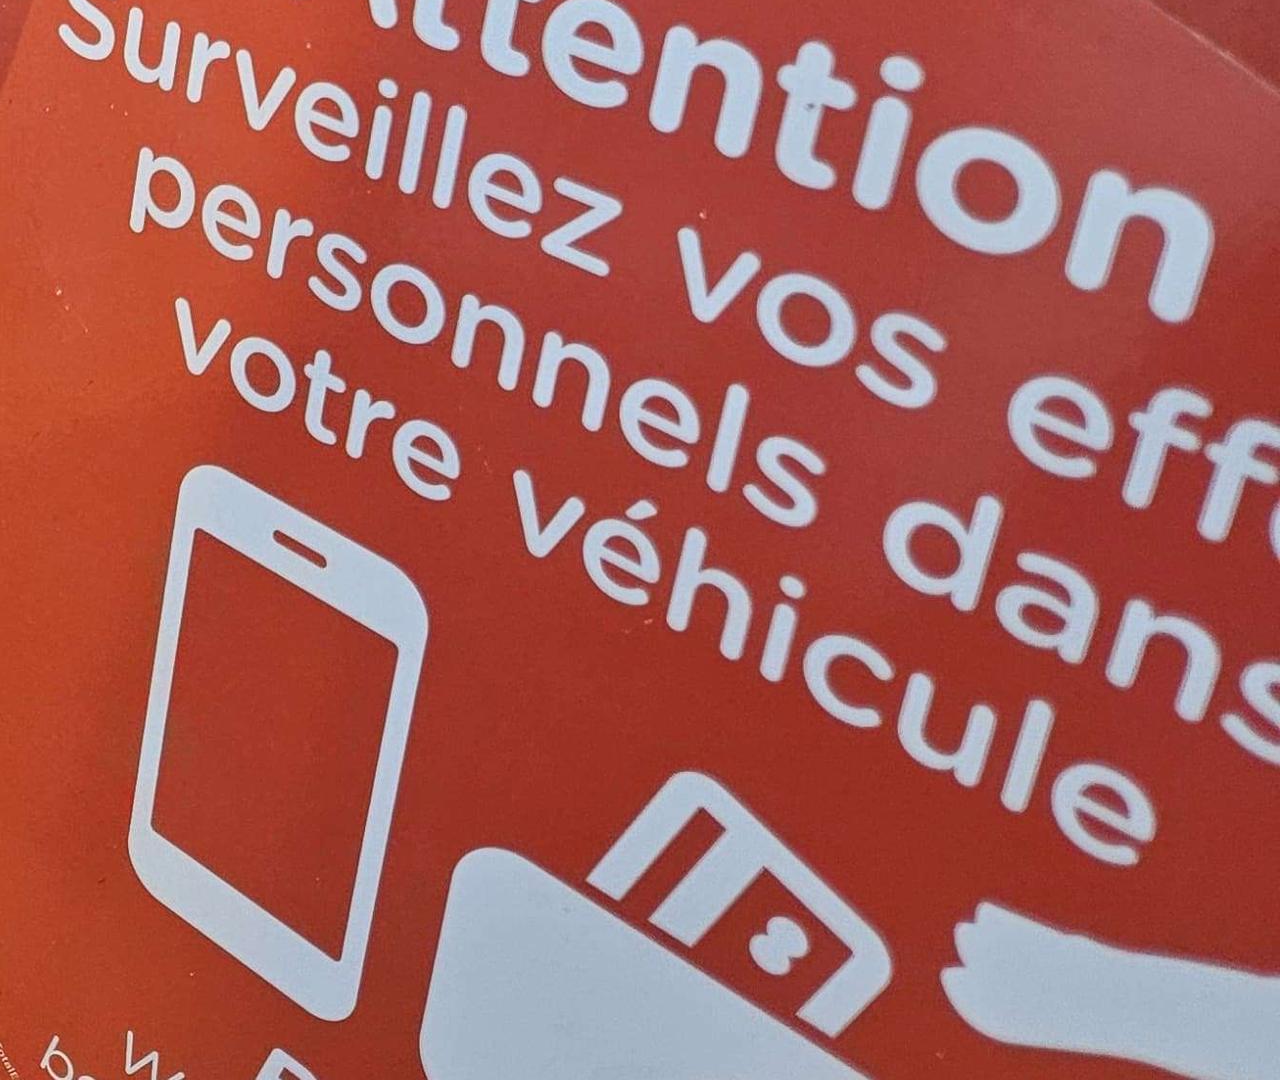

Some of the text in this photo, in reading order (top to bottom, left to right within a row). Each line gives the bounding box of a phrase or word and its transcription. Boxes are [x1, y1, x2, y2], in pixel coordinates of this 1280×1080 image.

[129, 146, 1280, 766] personnels dans
[174, 297, 1157, 866] votre véhicule
[677, 226, 947, 409] vos
[1006, 375, 1280, 560] eff
